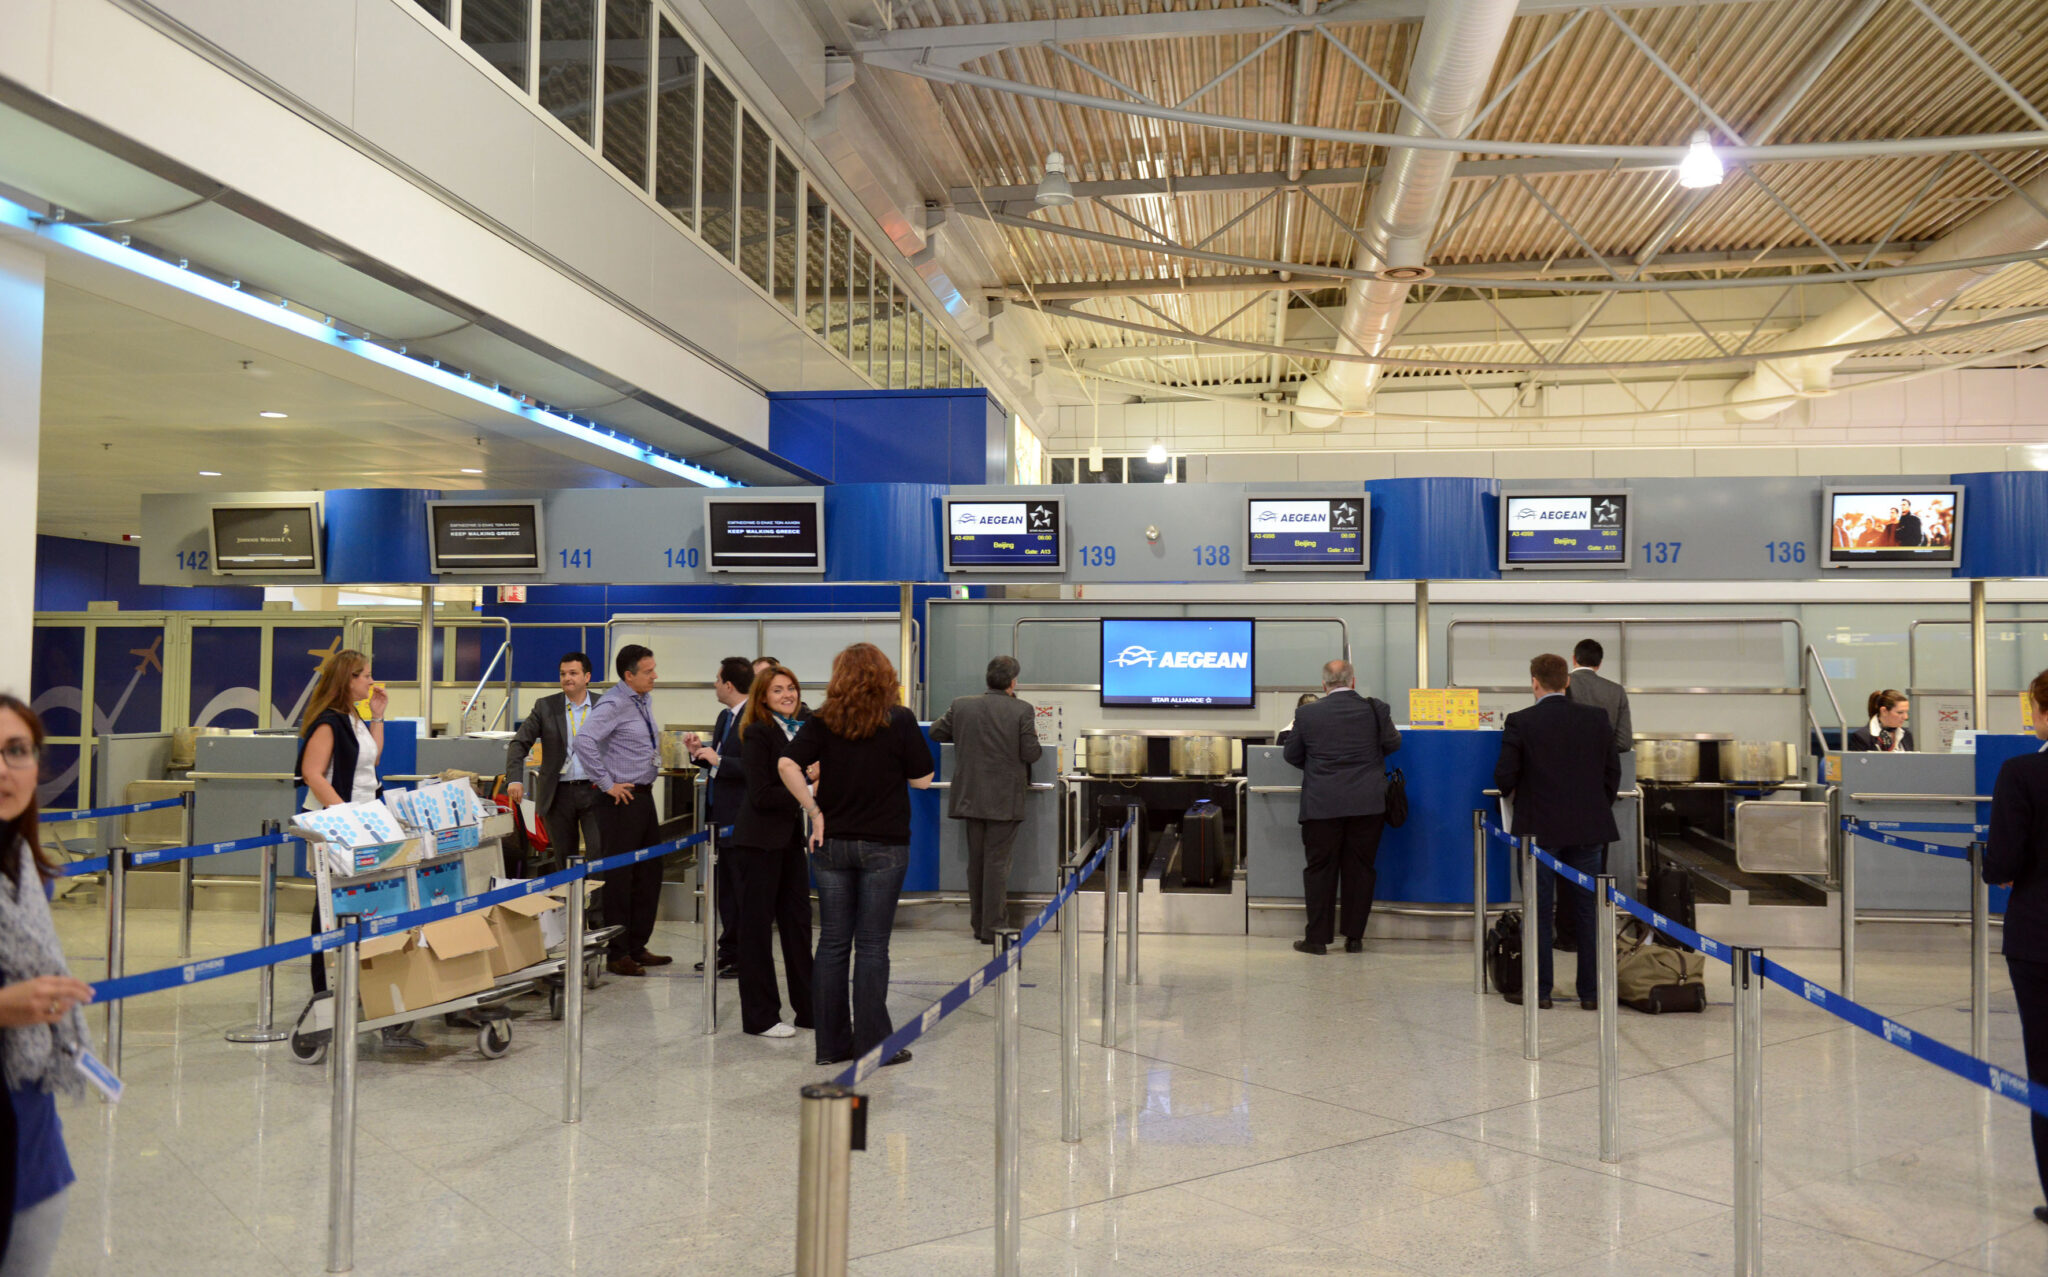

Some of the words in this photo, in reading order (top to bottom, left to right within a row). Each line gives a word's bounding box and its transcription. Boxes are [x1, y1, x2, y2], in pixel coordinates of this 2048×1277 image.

[979, 516, 1024, 525] AEGEAN
[1280, 514, 1326, 522] AEGEAN
[1540, 511, 1588, 520] AEGEAN
[1294, 540, 1317, 548] Beijing
[1554, 537, 1577, 546] Beijing
[176, 551, 208, 570] 142
[559, 548, 592, 568] 141
[664, 548, 698, 568] 140
[1079, 545, 1116, 567] 139
[1193, 545, 1230, 566] 138
[1642, 542, 1682, 563] 137
[1765, 541, 1805, 563] 136
[1158, 652, 1248, 668] AEGEAN
